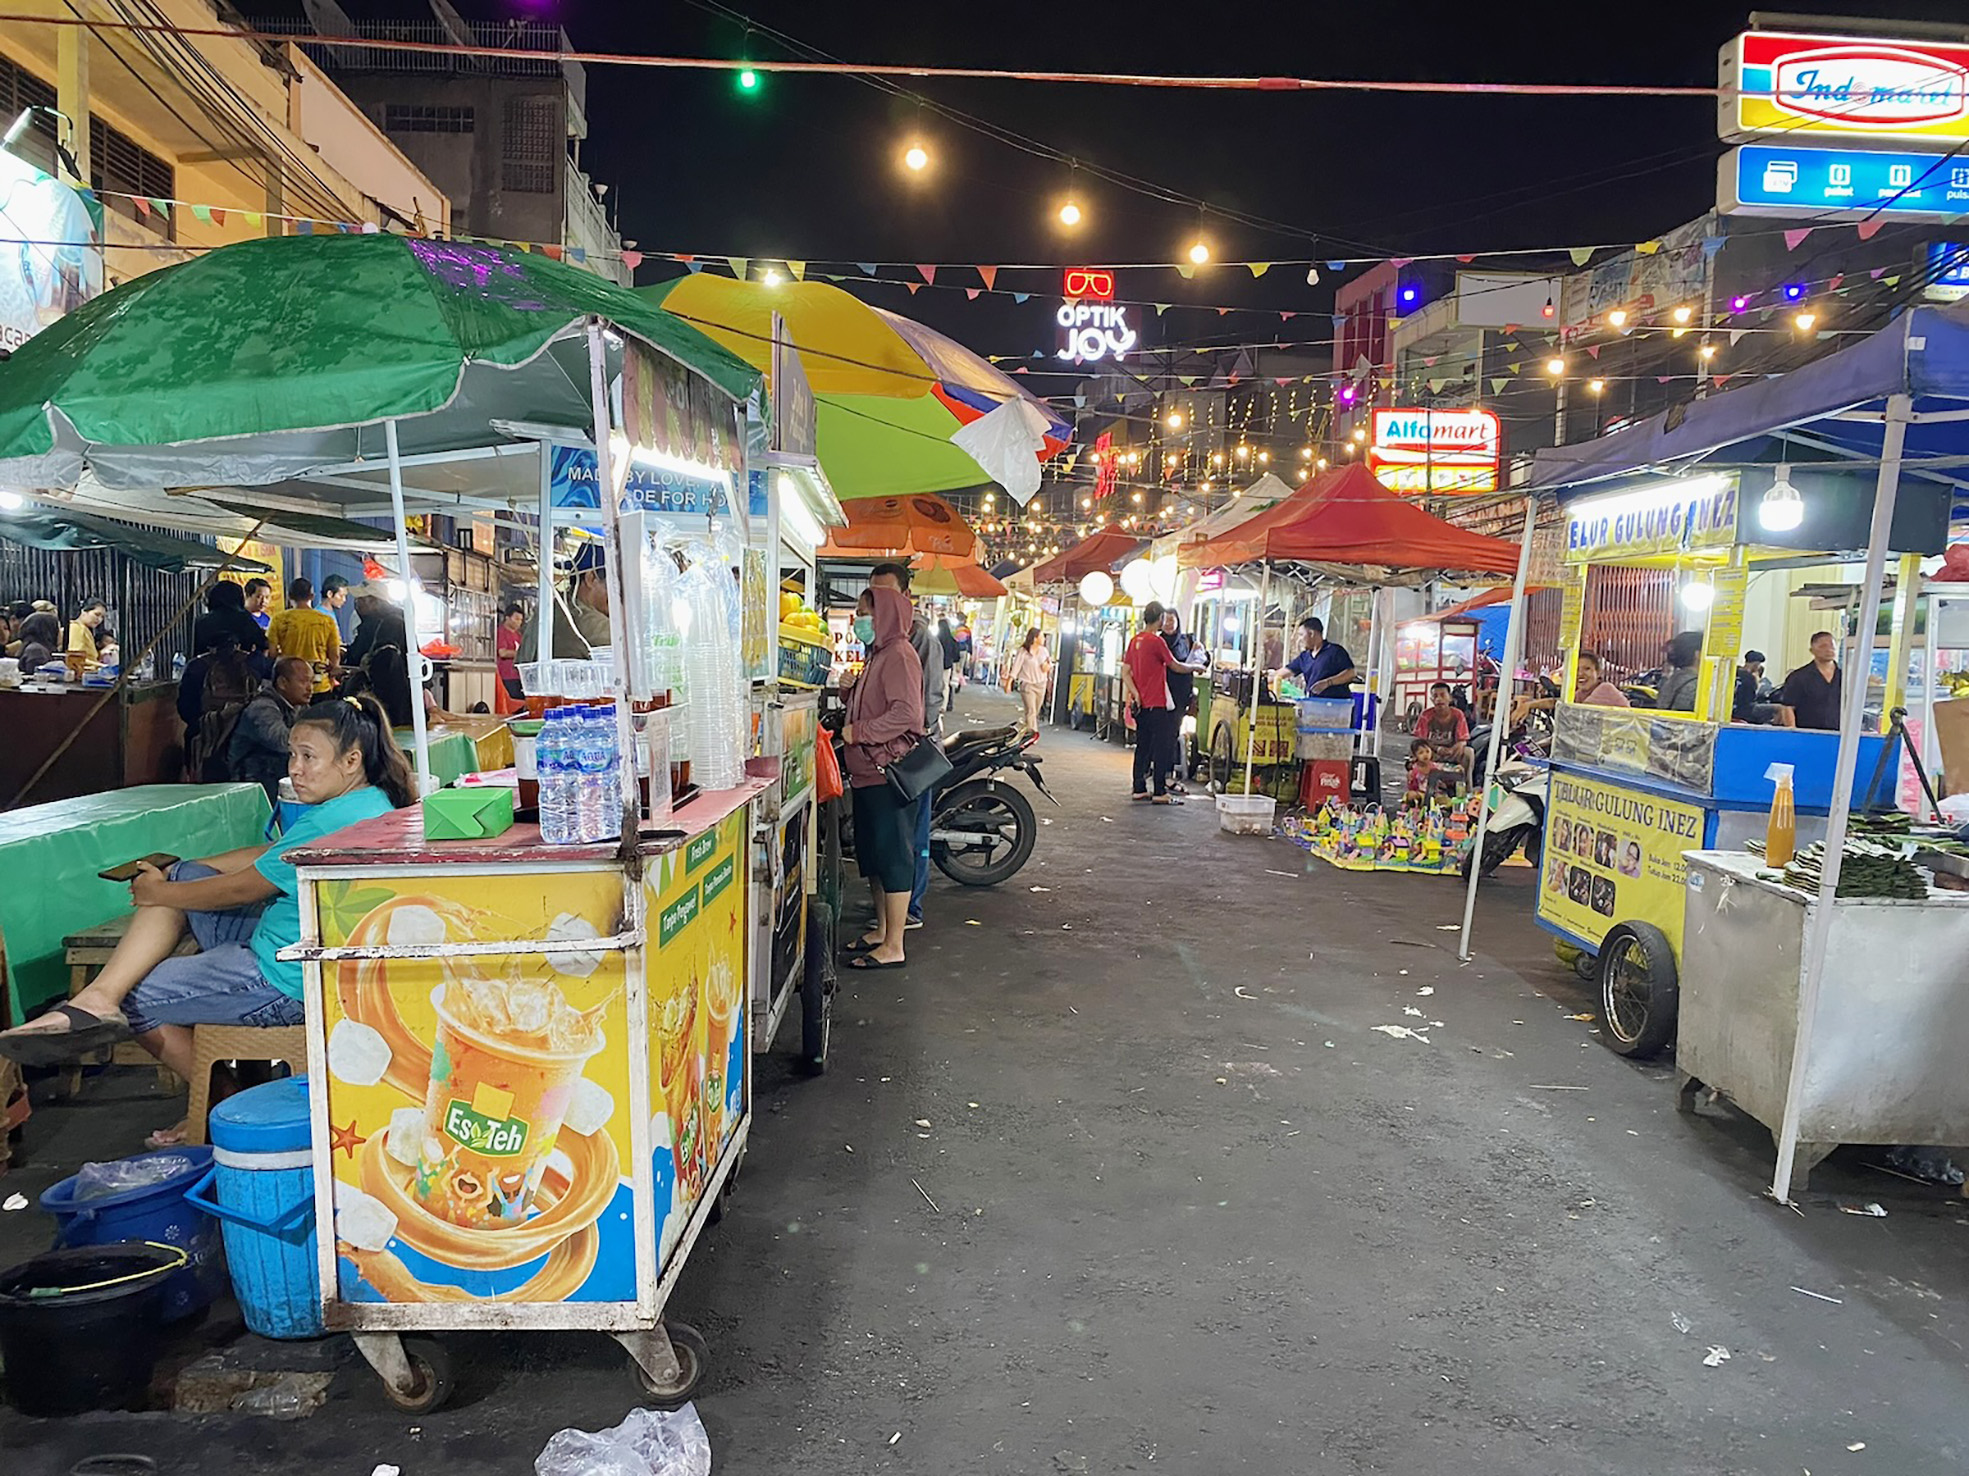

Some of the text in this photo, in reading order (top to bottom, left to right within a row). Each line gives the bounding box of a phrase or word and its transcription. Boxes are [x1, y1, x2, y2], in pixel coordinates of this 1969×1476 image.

[1946, 190, 1969, 201] puls
[1057, 305, 1127, 328] OPTIK
[1057, 327, 1136, 362] JOY
[1386, 420, 1489, 440] Alfamart
[661, 490, 696, 506] FOR
[1614, 503, 1681, 543] GULUNG
[580, 751, 606, 762] AQUA
[1595, 791, 1654, 827] GULUNG
[1657, 808, 1698, 839] INEZ
[448, 1107, 523, 1151] Es Teh
